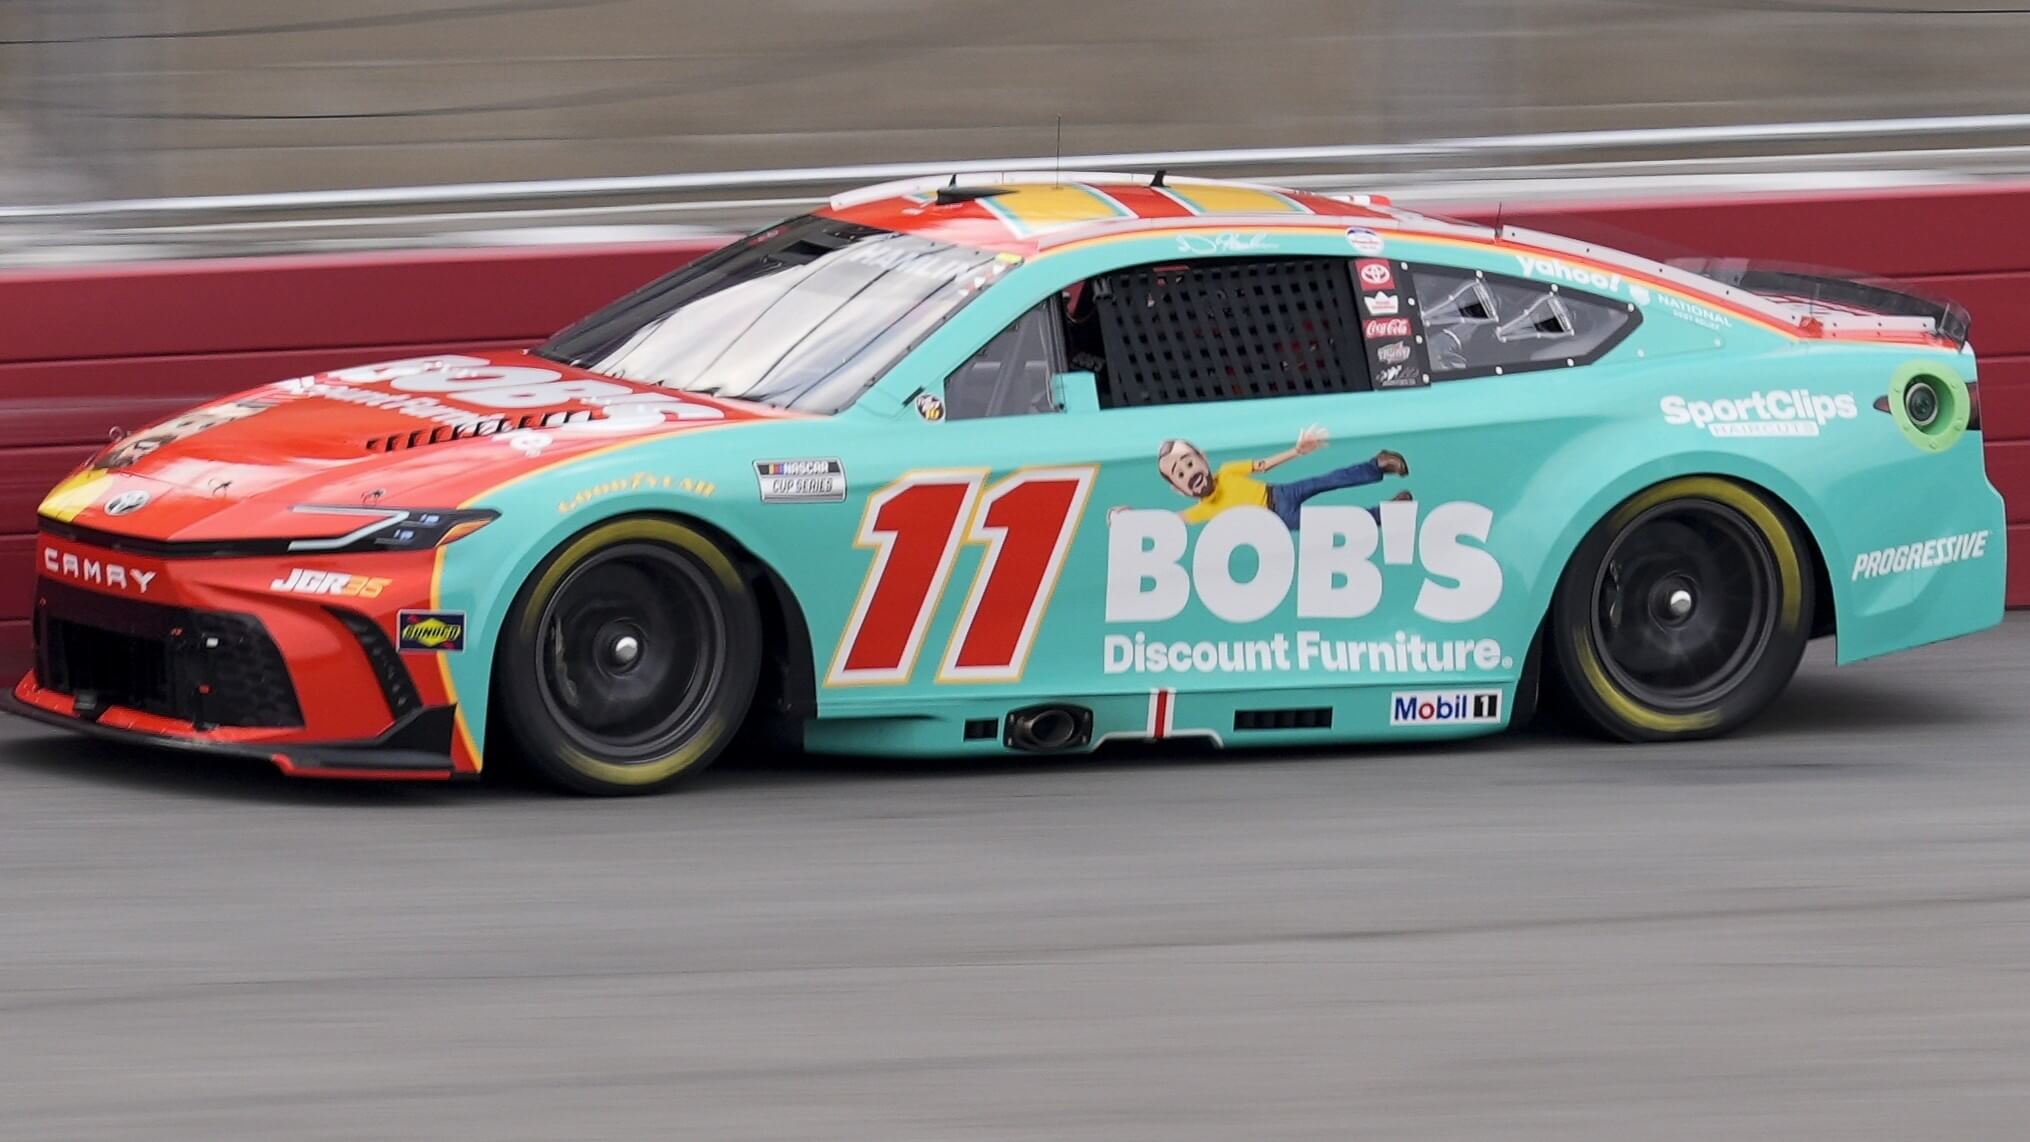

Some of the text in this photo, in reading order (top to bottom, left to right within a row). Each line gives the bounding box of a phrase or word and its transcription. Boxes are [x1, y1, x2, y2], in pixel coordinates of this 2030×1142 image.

[1516, 255, 1622, 292] yahoo!
[1657, 293, 1734, 328] NATIONAL
[1660, 389, 1858, 428] SportClips
[772, 478, 833, 494] CUP SERIES
[783, 461, 829, 476] NASCAR
[44, 547, 156, 594] CAMRY
[1105, 501, 1503, 622] BOB'S
[1852, 530, 1988, 580] PROGRESSIVE
[822, 467, 1100, 688] 11
[402, 623, 462, 642] SUNOCO
[1103, 632, 1291, 674] Discount
[1394, 695, 1468, 720] Mobil
